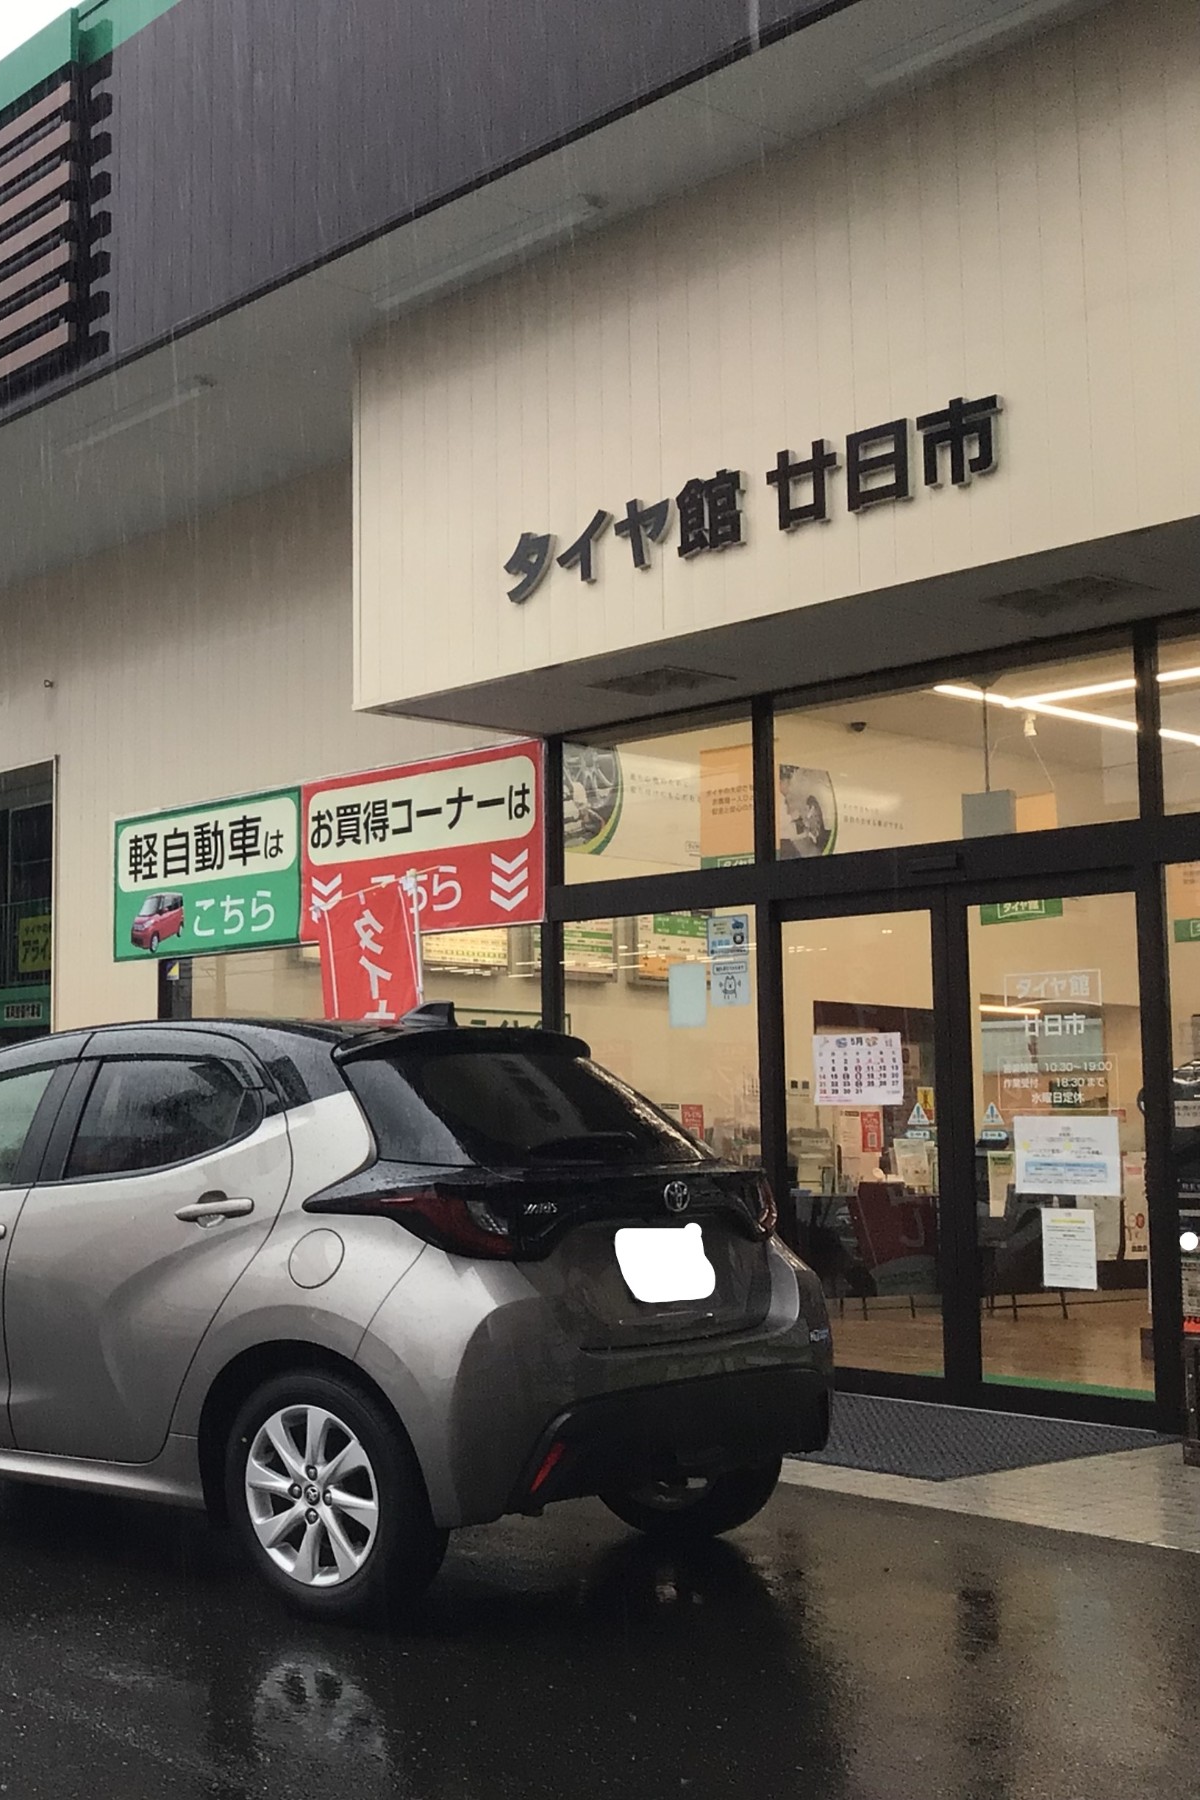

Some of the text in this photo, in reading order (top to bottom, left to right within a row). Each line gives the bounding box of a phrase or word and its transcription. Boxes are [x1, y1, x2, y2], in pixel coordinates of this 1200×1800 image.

[504, 394, 1003, 604] タイヤ館 廿日市
[310, 782, 531, 849] お買得コーナーは
[129, 814, 285, 882] 軽自動車は
[193, 890, 275, 937] こちら
[21, 937, 51, 963] アライ
[1016, 974, 1090, 999] タイヤ館
[1022, 1012, 1086, 1037] 廿日市
